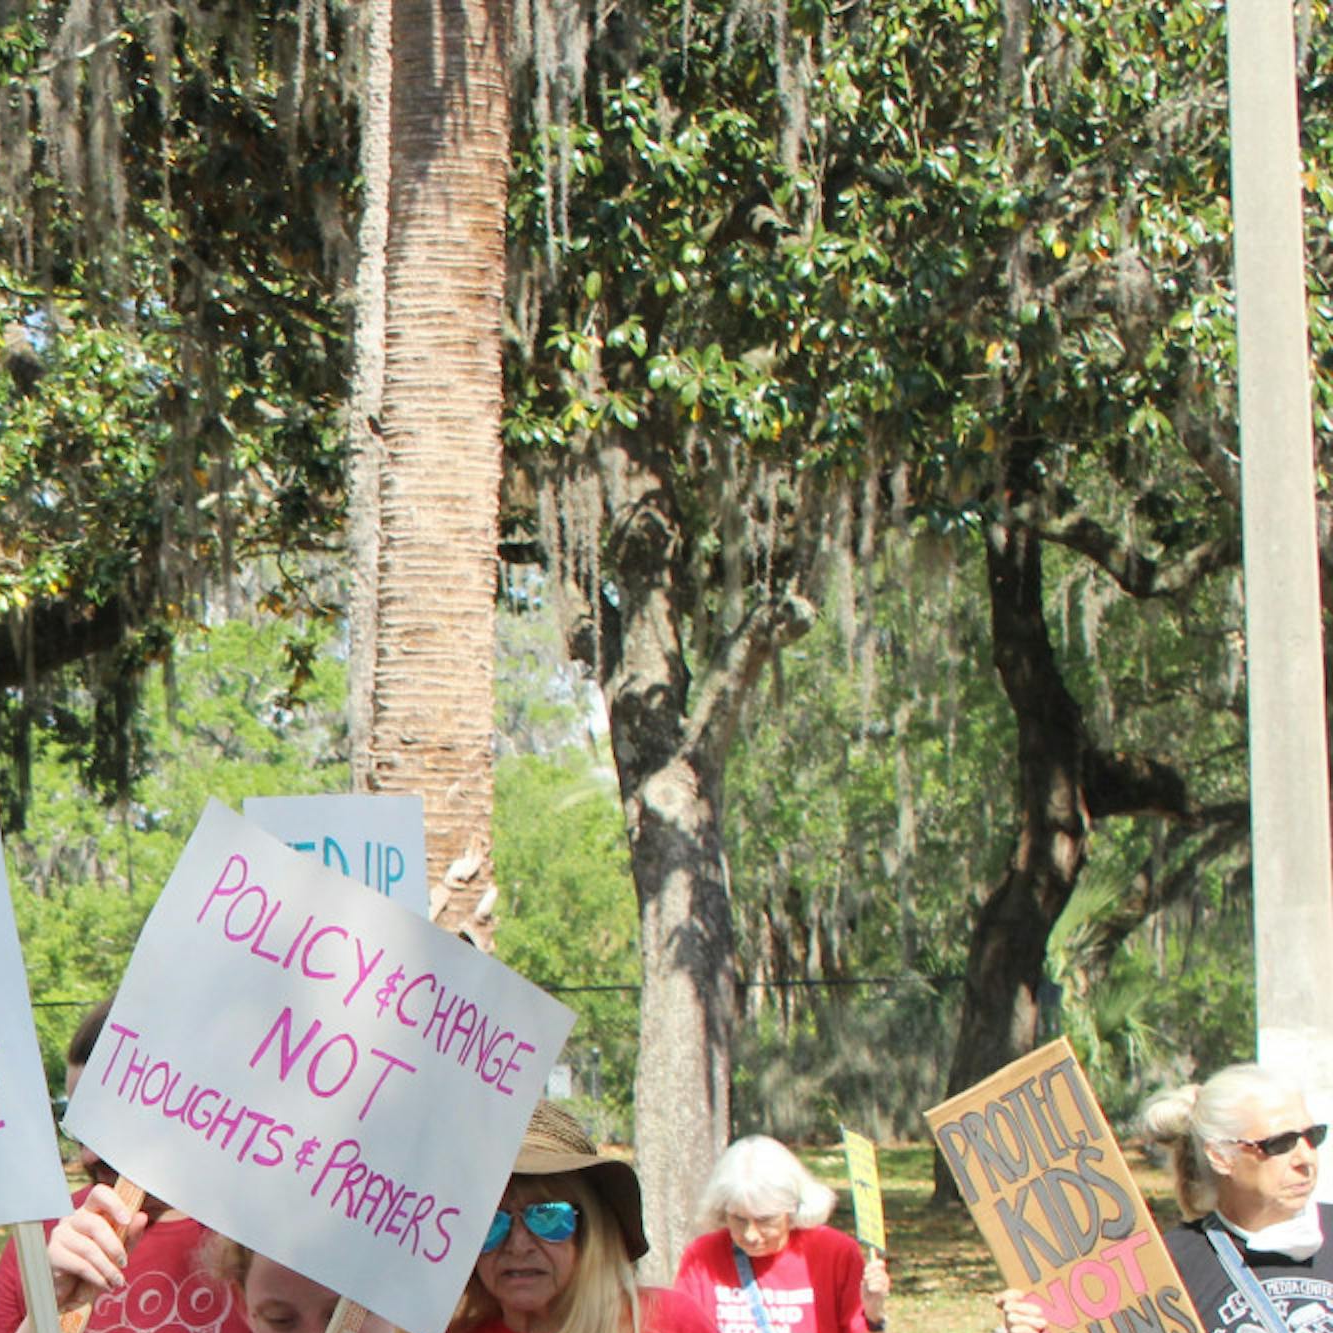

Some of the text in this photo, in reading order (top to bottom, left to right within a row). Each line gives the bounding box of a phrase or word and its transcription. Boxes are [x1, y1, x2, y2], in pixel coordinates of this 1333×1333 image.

[197, 853, 384, 1007] POLICY
[395, 973, 537, 1096] CHANGE
[248, 1006, 417, 1122] NOT
[937, 1056, 1103, 1204] PROTECT
[101, 1022, 297, 1167] THOUGHTS
[309, 1138, 462, 1263] PRAYERS
[993, 1145, 1136, 1283] KIDS
